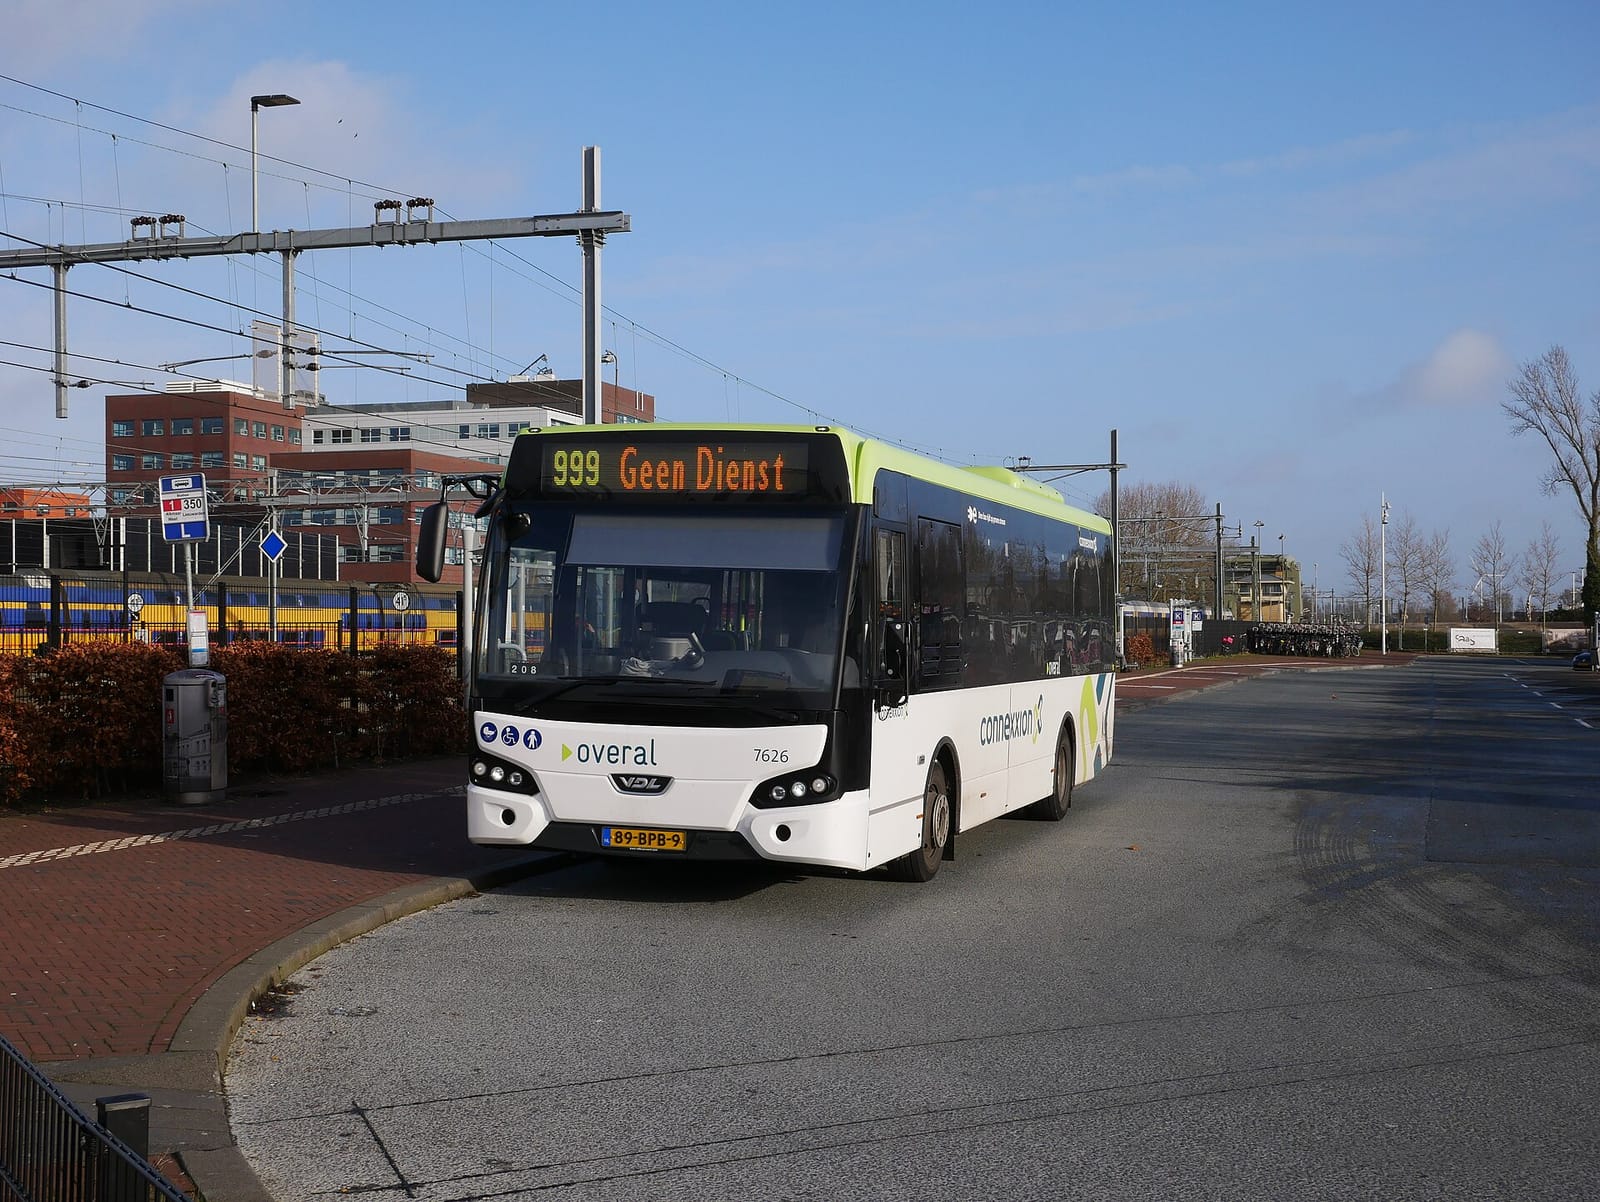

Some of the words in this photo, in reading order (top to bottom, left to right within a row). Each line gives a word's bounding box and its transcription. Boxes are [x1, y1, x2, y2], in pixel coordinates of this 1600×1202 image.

[553, 450, 600, 486] 999
[619, 446, 685, 490] Geen
[696, 446, 785, 491] Dienst
[169, 500, 175, 511] 1
[183, 498, 202, 510] 350
[181, 523, 191, 538] L
[511, 664, 537, 674] 208
[980, 709, 1033, 746] connexxion
[577, 738, 657, 766] overal
[753, 748, 789, 763] 7626
[618, 776, 663, 789] VDL
[615, 830, 681, 848] 89-BPB-9
